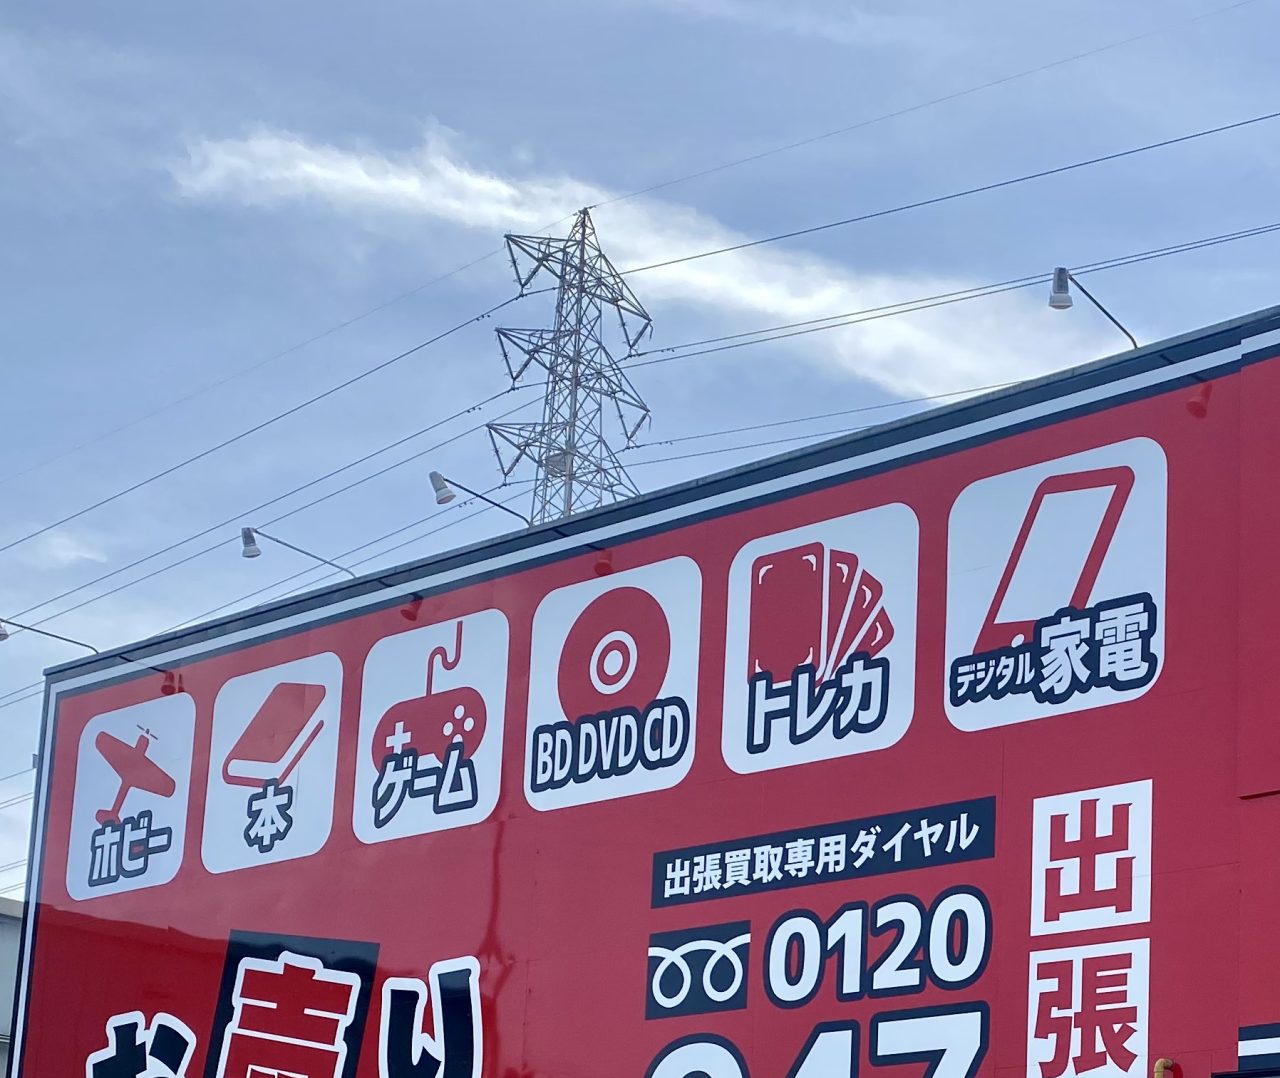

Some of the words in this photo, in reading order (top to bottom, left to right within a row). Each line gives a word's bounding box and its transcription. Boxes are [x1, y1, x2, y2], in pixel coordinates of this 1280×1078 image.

[955, 600, 1153, 697] デジタル家電
[535, 730, 573, 787] BD
[578, 715, 640, 779] DVD
[641, 703, 687, 766] CD
[751, 659, 888, 748] トレカ
[247, 783, 291, 849] 本
[374, 746, 478, 826] ゲーム
[90, 815, 171, 884] ホビー
[663, 812, 980, 899] 出張買取専用ダイヤル
[767, 891, 988, 1003] 0120
